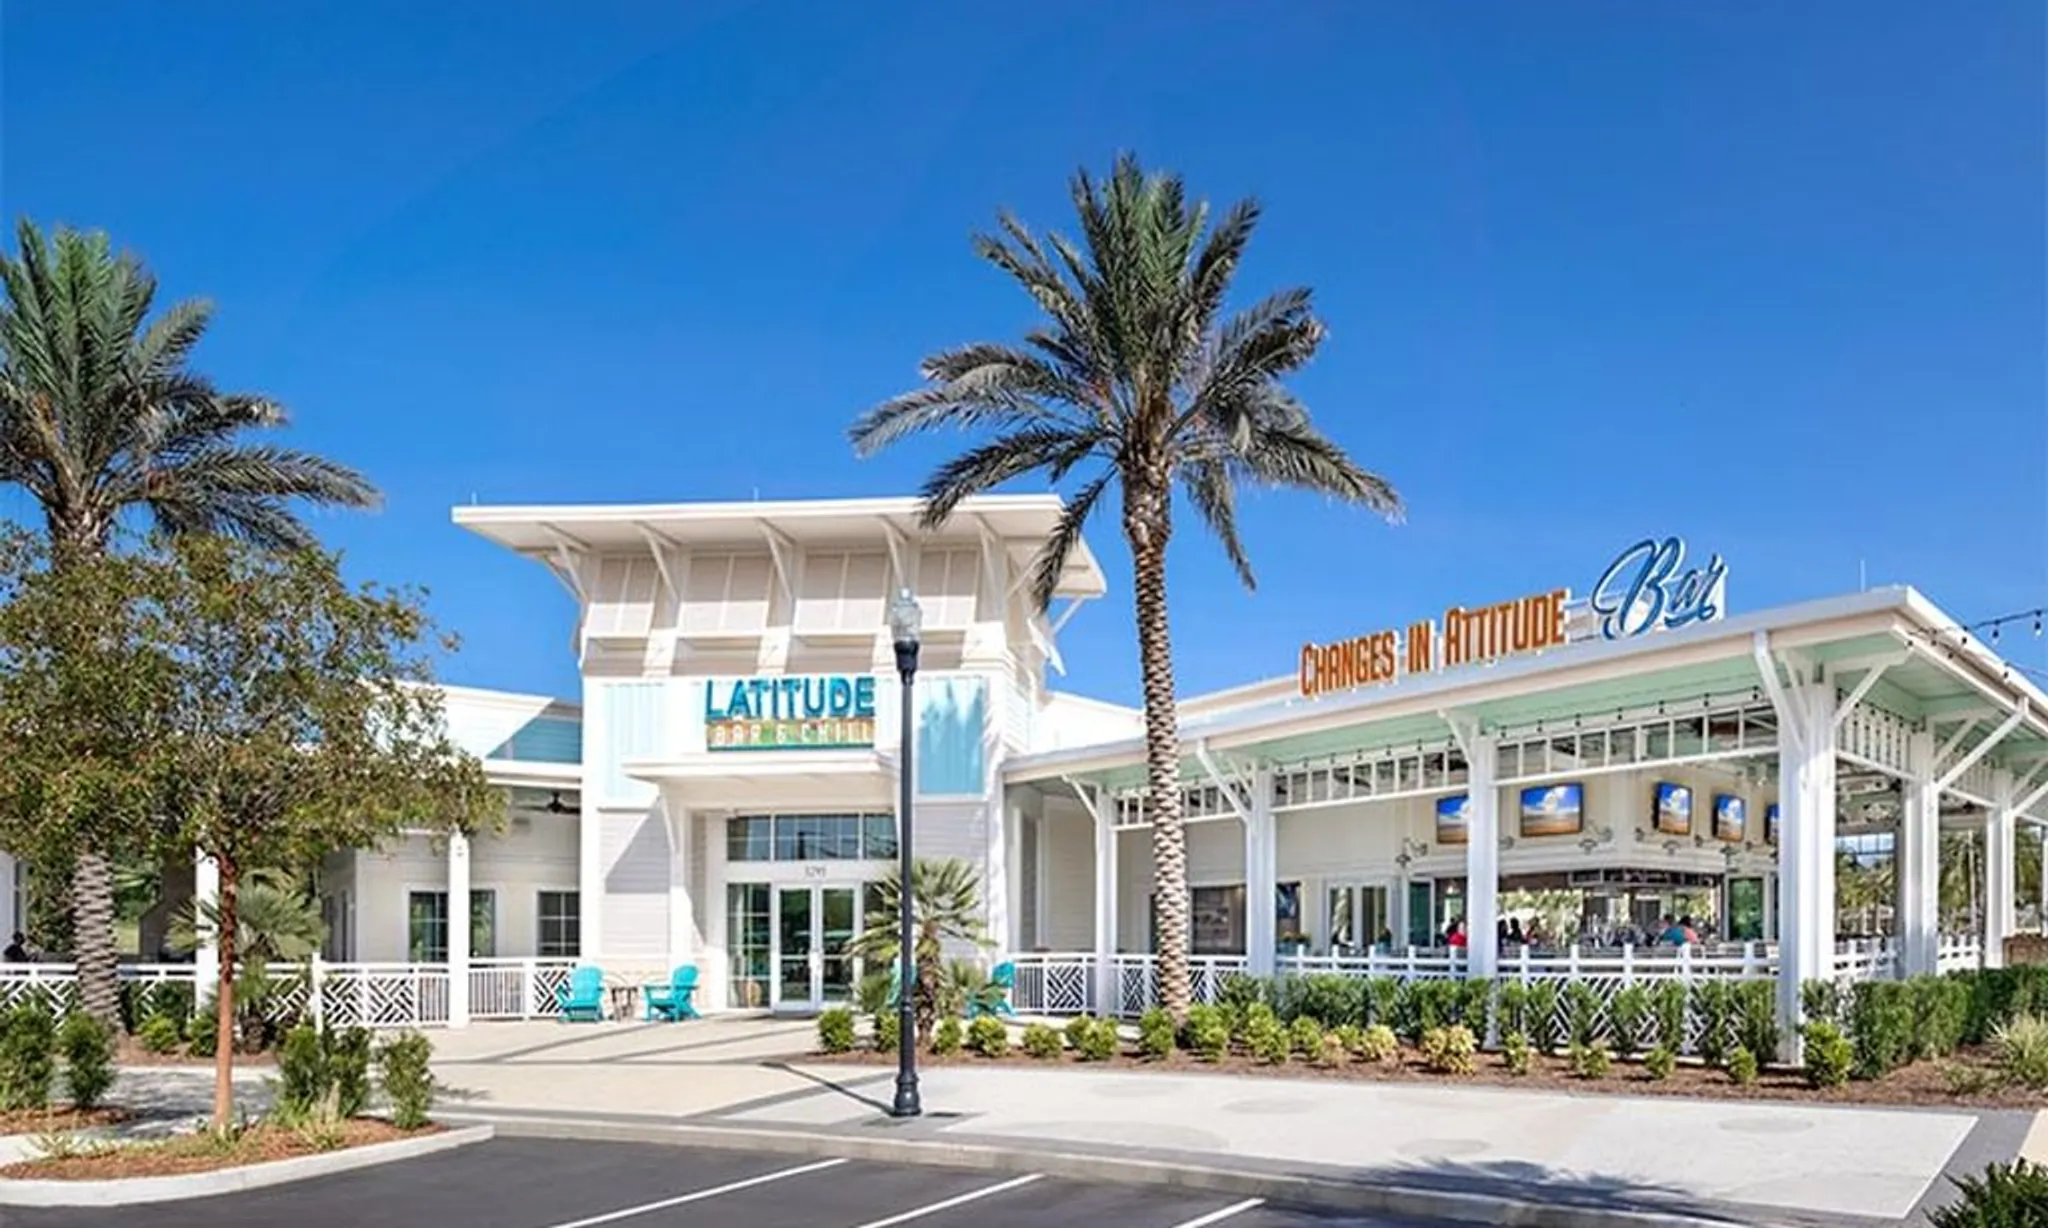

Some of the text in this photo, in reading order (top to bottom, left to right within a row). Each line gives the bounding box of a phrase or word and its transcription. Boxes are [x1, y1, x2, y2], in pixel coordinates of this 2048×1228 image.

[1300, 536, 1726, 697] CHANGES IN ATTITUDE Bar
[705, 676, 876, 721] LATITUDE
